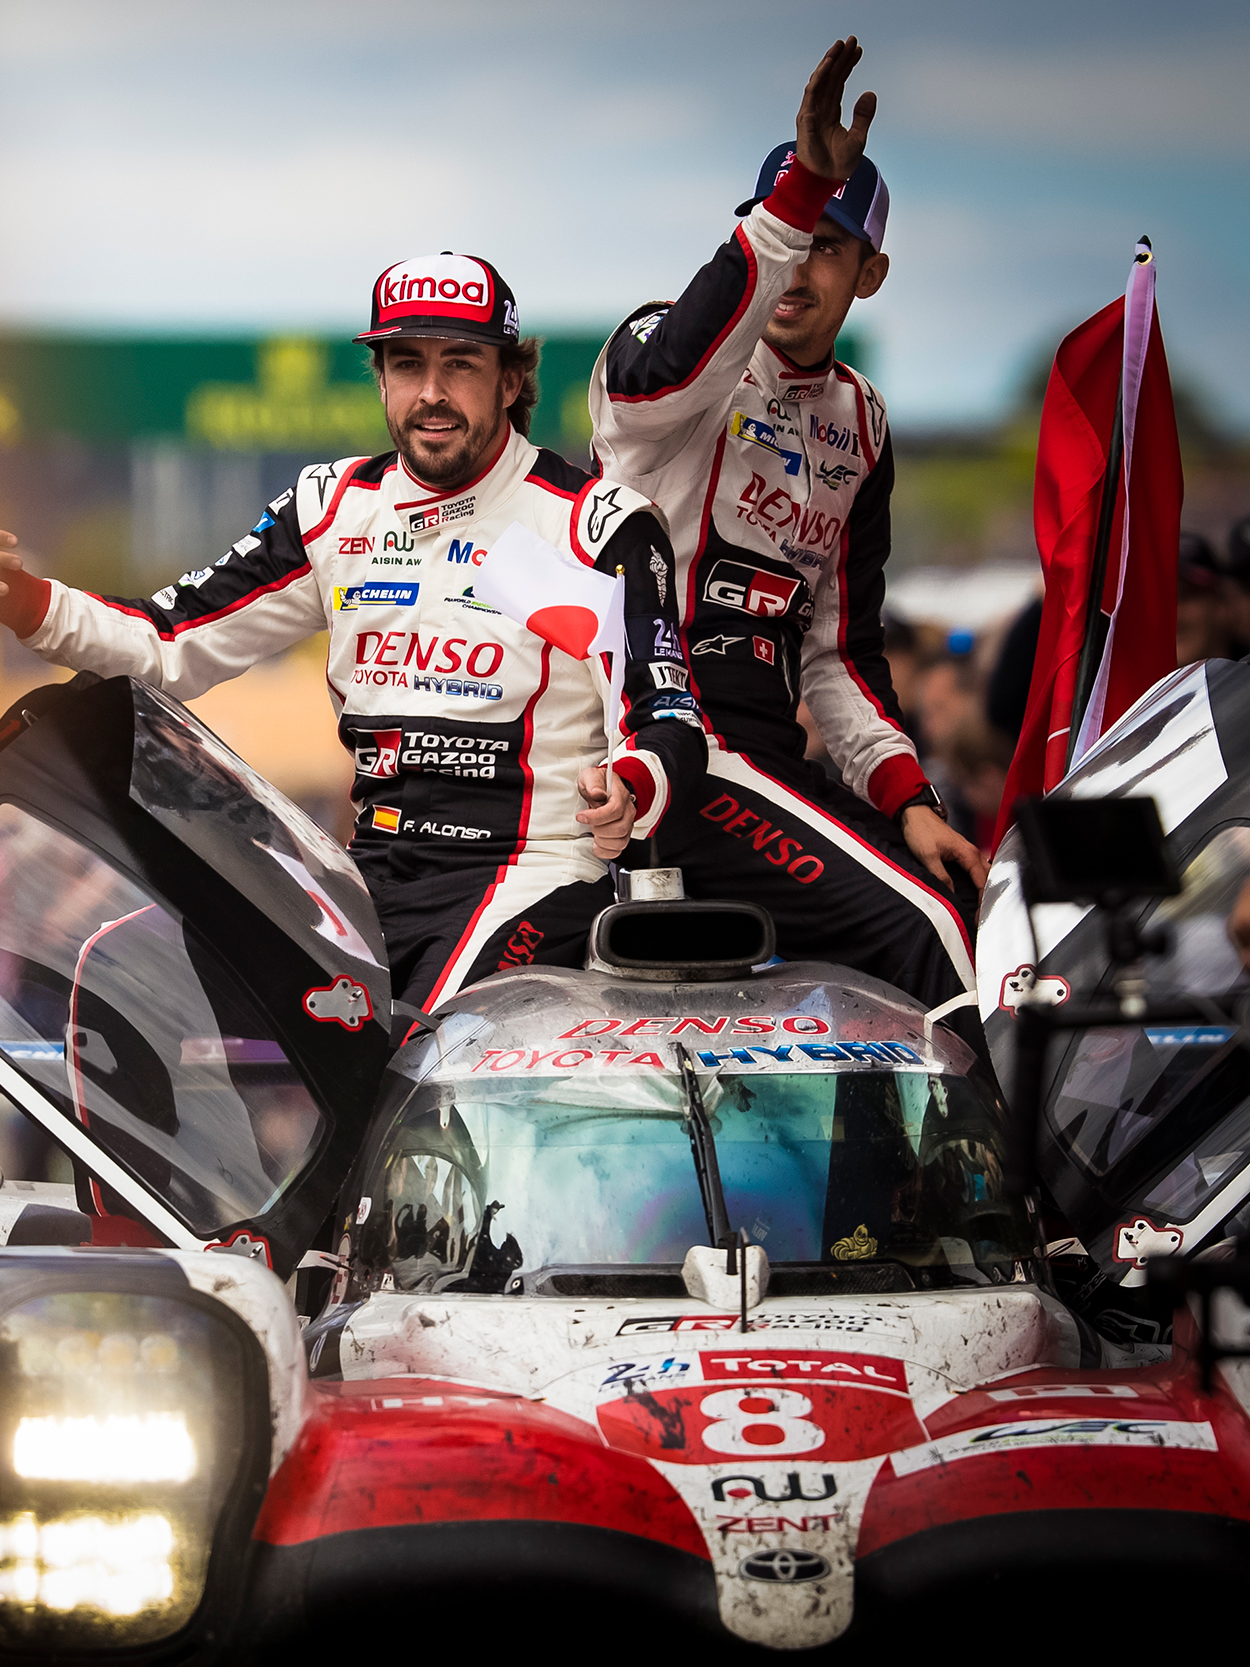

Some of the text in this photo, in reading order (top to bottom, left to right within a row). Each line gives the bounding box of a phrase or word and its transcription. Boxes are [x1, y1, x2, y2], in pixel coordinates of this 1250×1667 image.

[384, 273, 484, 306] kimoa
[810, 414, 850, 451] Mobil
[411, 495, 476, 533] GR TOYOTA
[441, 503, 475, 517] GAZOO
[441, 509, 475, 523] Racing
[371, 557, 422, 566] AISIN AW
[708, 580, 786, 616] GR
[355, 631, 505, 678] DENSO
[351, 669, 503, 701] TOYOTA HYBRID
[355, 731, 510, 776] GR TOYOTA
[401, 749, 496, 765] GAZOO
[403, 820, 416, 832] F.
[700, 792, 825, 884] DENSO
[555, 1017, 832, 1041] DENSO
[471, 1040, 927, 1073] TOYOTA HYBRID
[618, 1316, 734, 1336] GR
[710, 1357, 898, 1383] TOTAL
[700, 1387, 825, 1456] 8
[716, 1513, 840, 1533] ZENT
